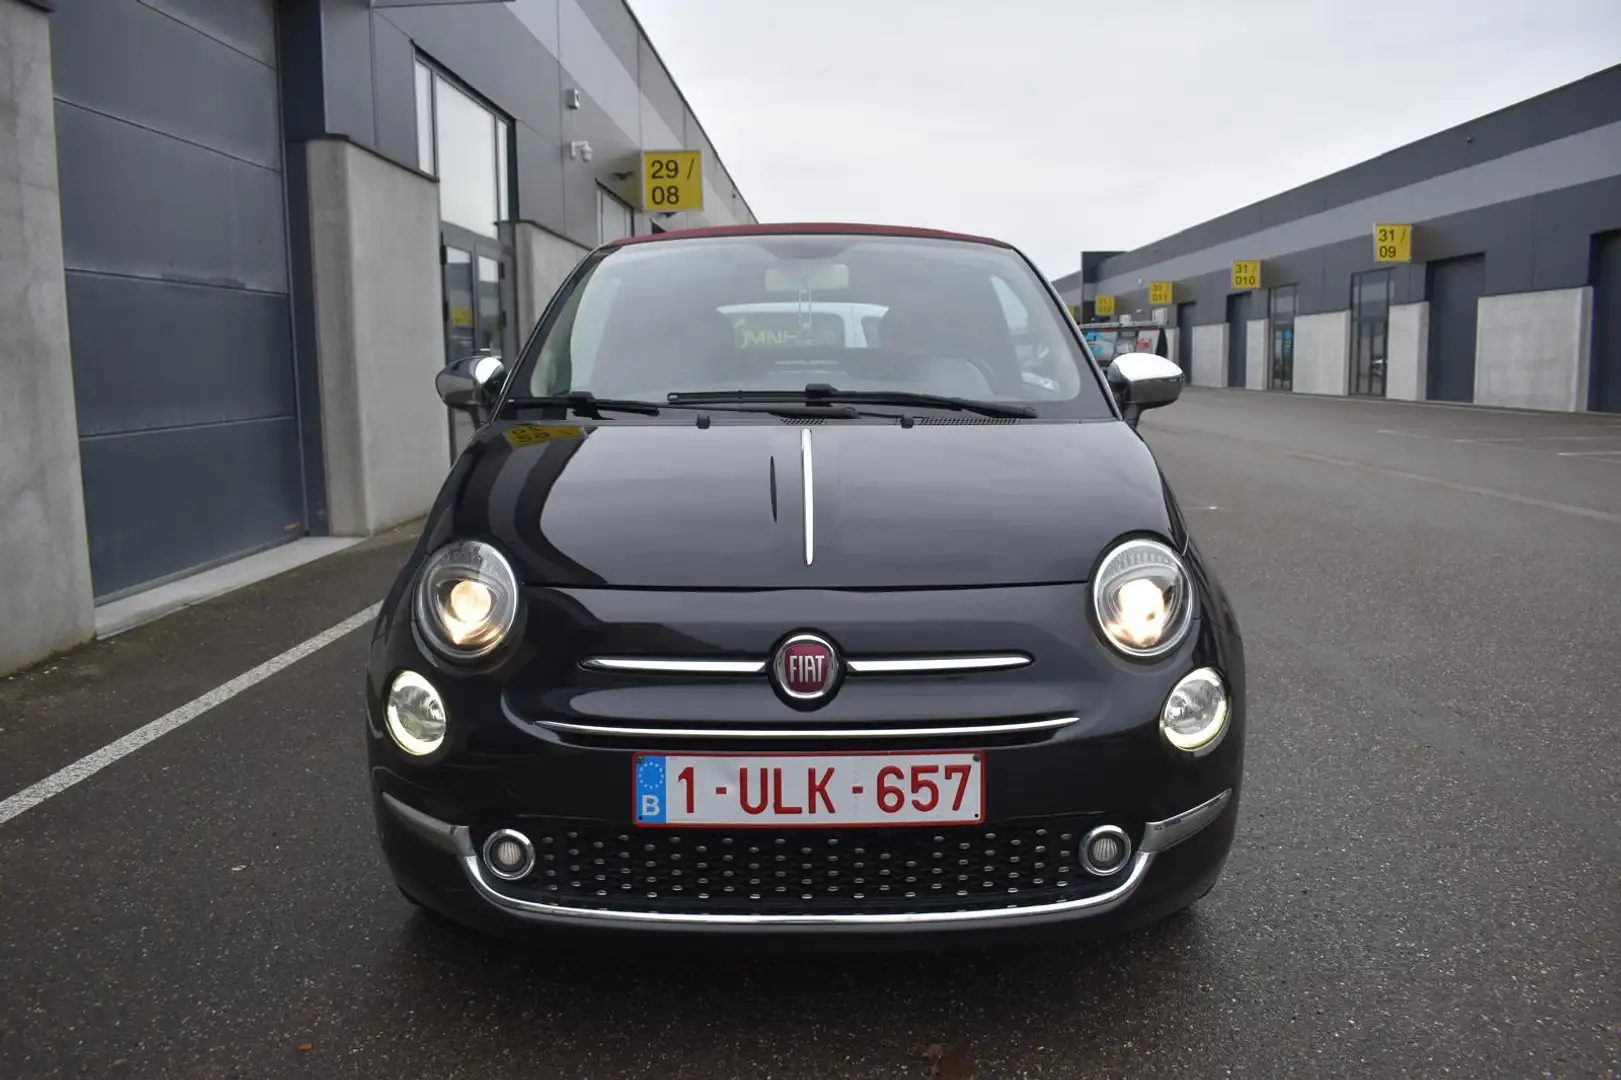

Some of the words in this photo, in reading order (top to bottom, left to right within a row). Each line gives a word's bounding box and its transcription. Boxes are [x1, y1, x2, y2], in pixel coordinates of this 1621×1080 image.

[651, 159, 679, 179] 29
[652, 186, 679, 205] 08
[1379, 229, 1395, 242] 31
[1379, 246, 1396, 258] 09
[1235, 263, 1248, 274] 31
[1235, 275, 1256, 286] 010
[789, 655, 825, 683] FIAT
[641, 794, 661, 816] B
